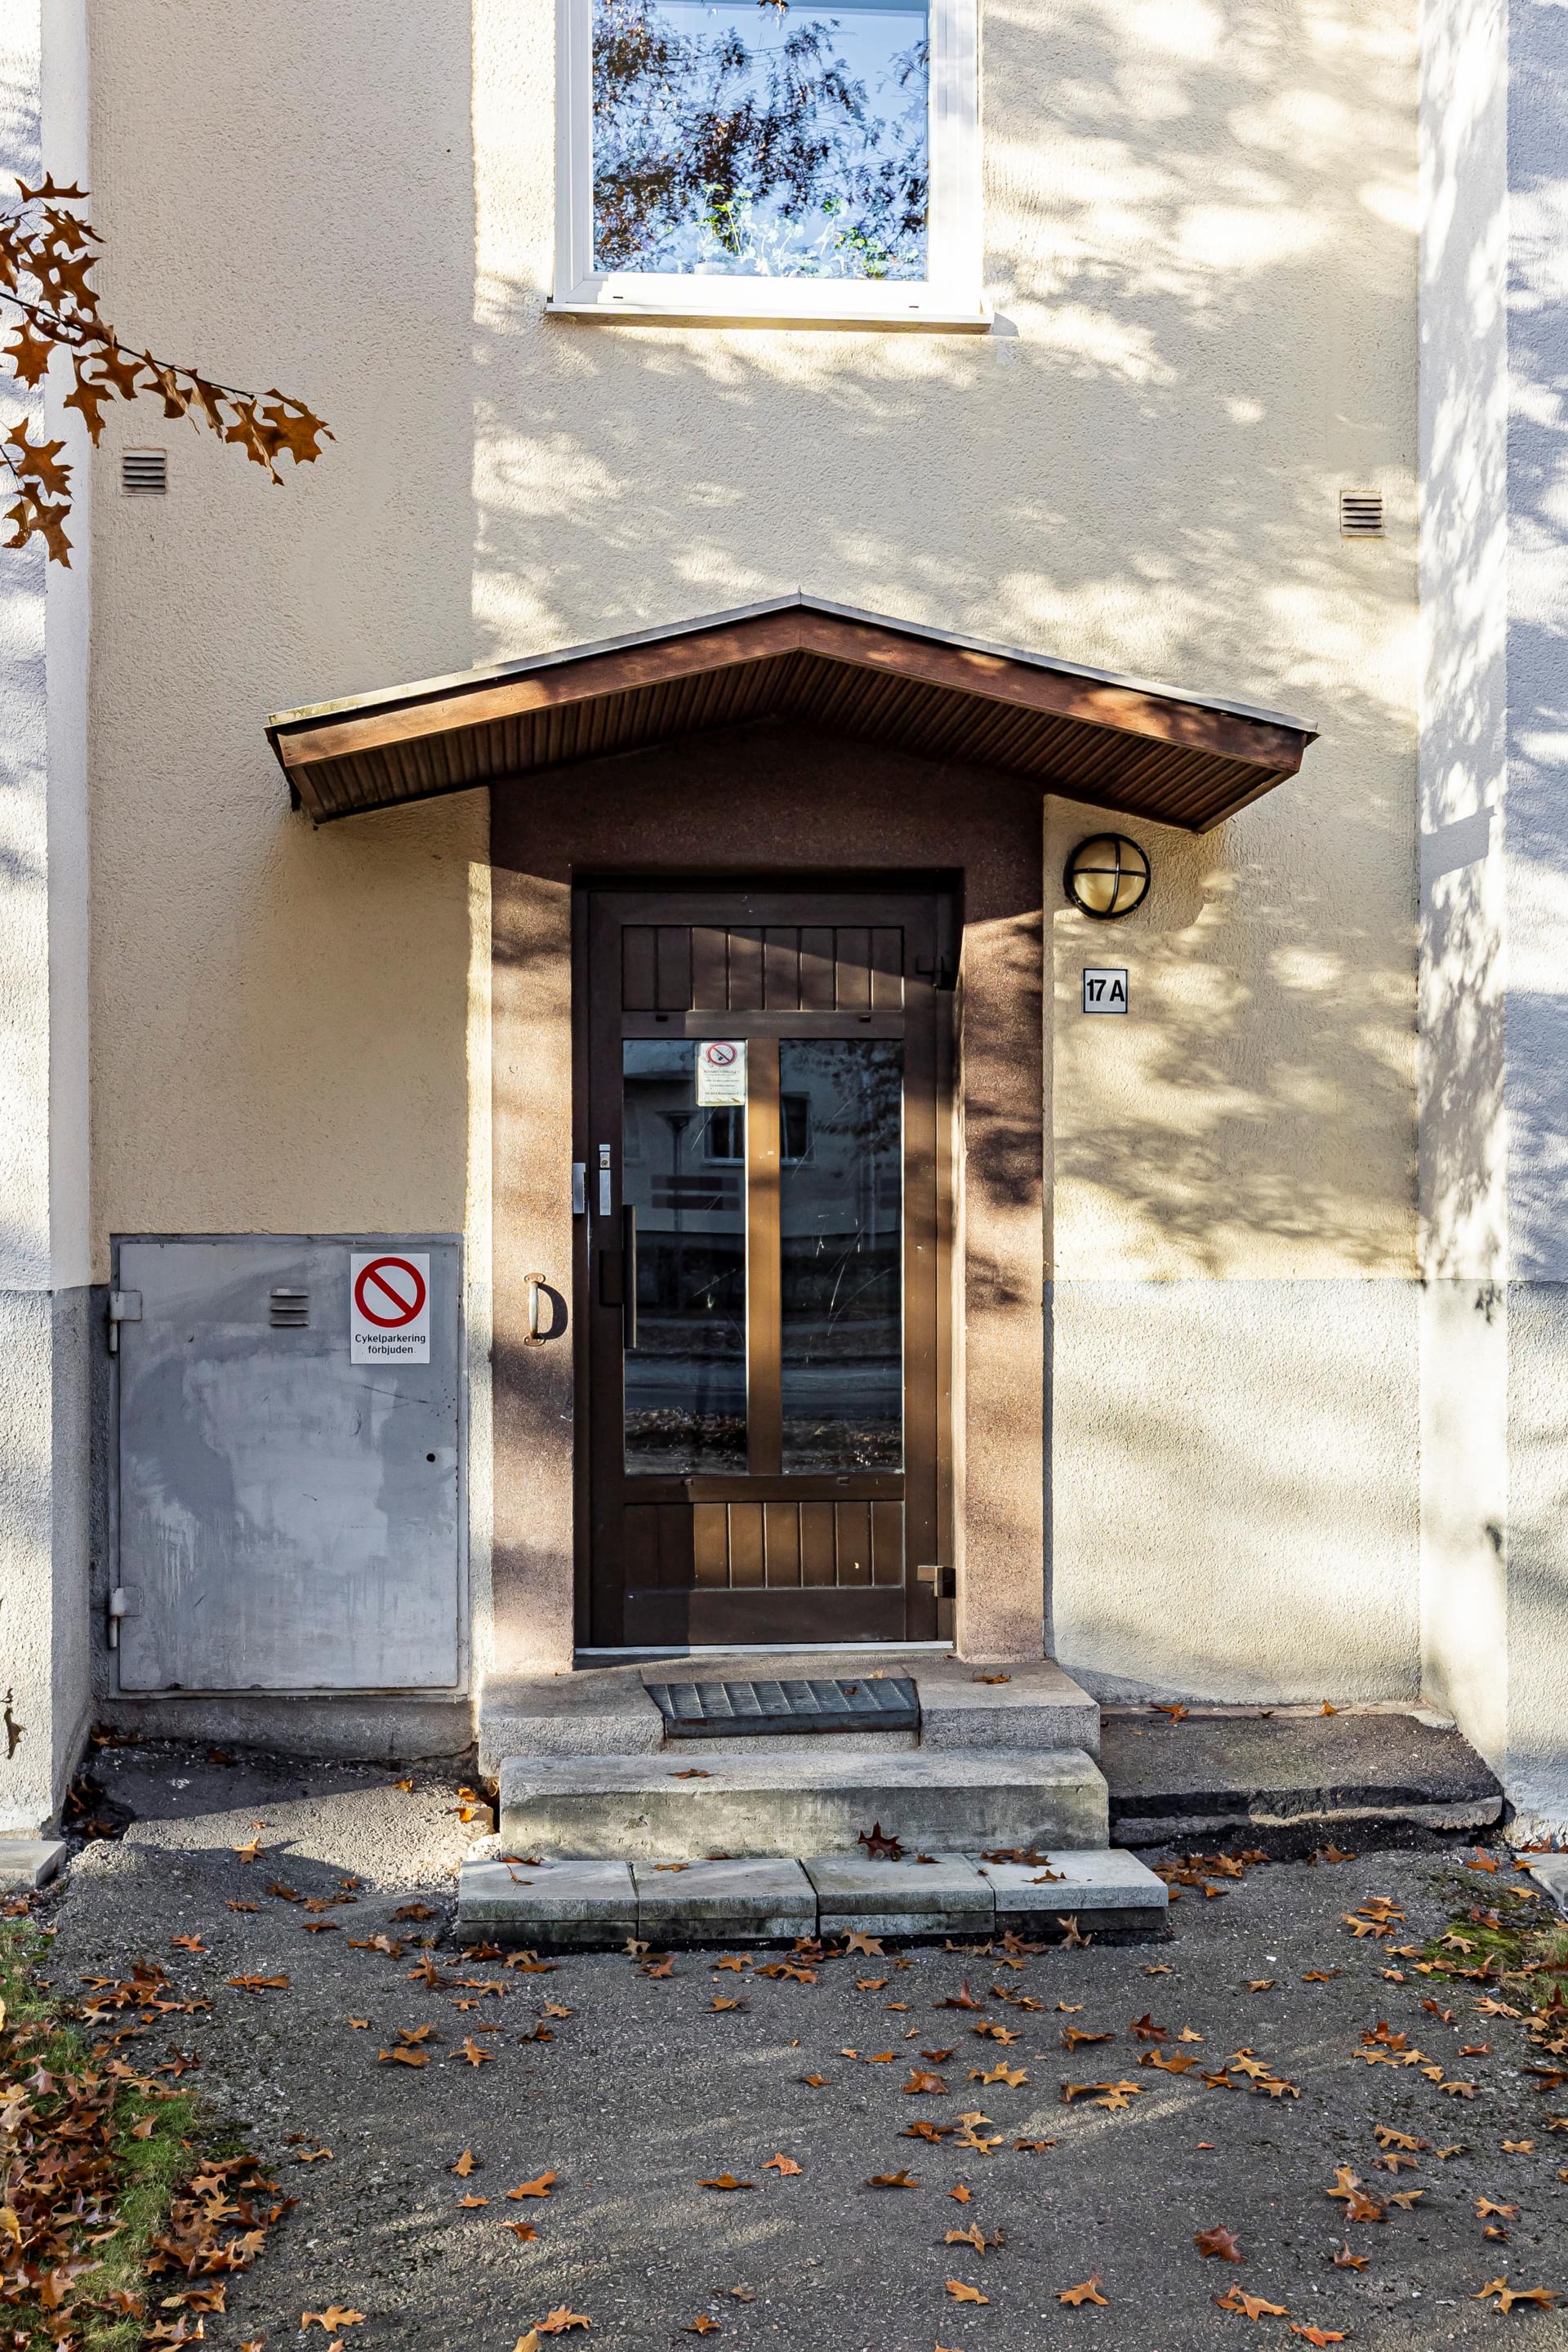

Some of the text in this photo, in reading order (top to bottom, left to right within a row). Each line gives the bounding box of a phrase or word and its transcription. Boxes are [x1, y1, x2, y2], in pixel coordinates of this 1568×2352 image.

[1086, 979, 1125, 1002] 17 A
[355, 1334, 426, 1344] Cykelparkering
[368, 1345, 414, 1355] förbjuden
